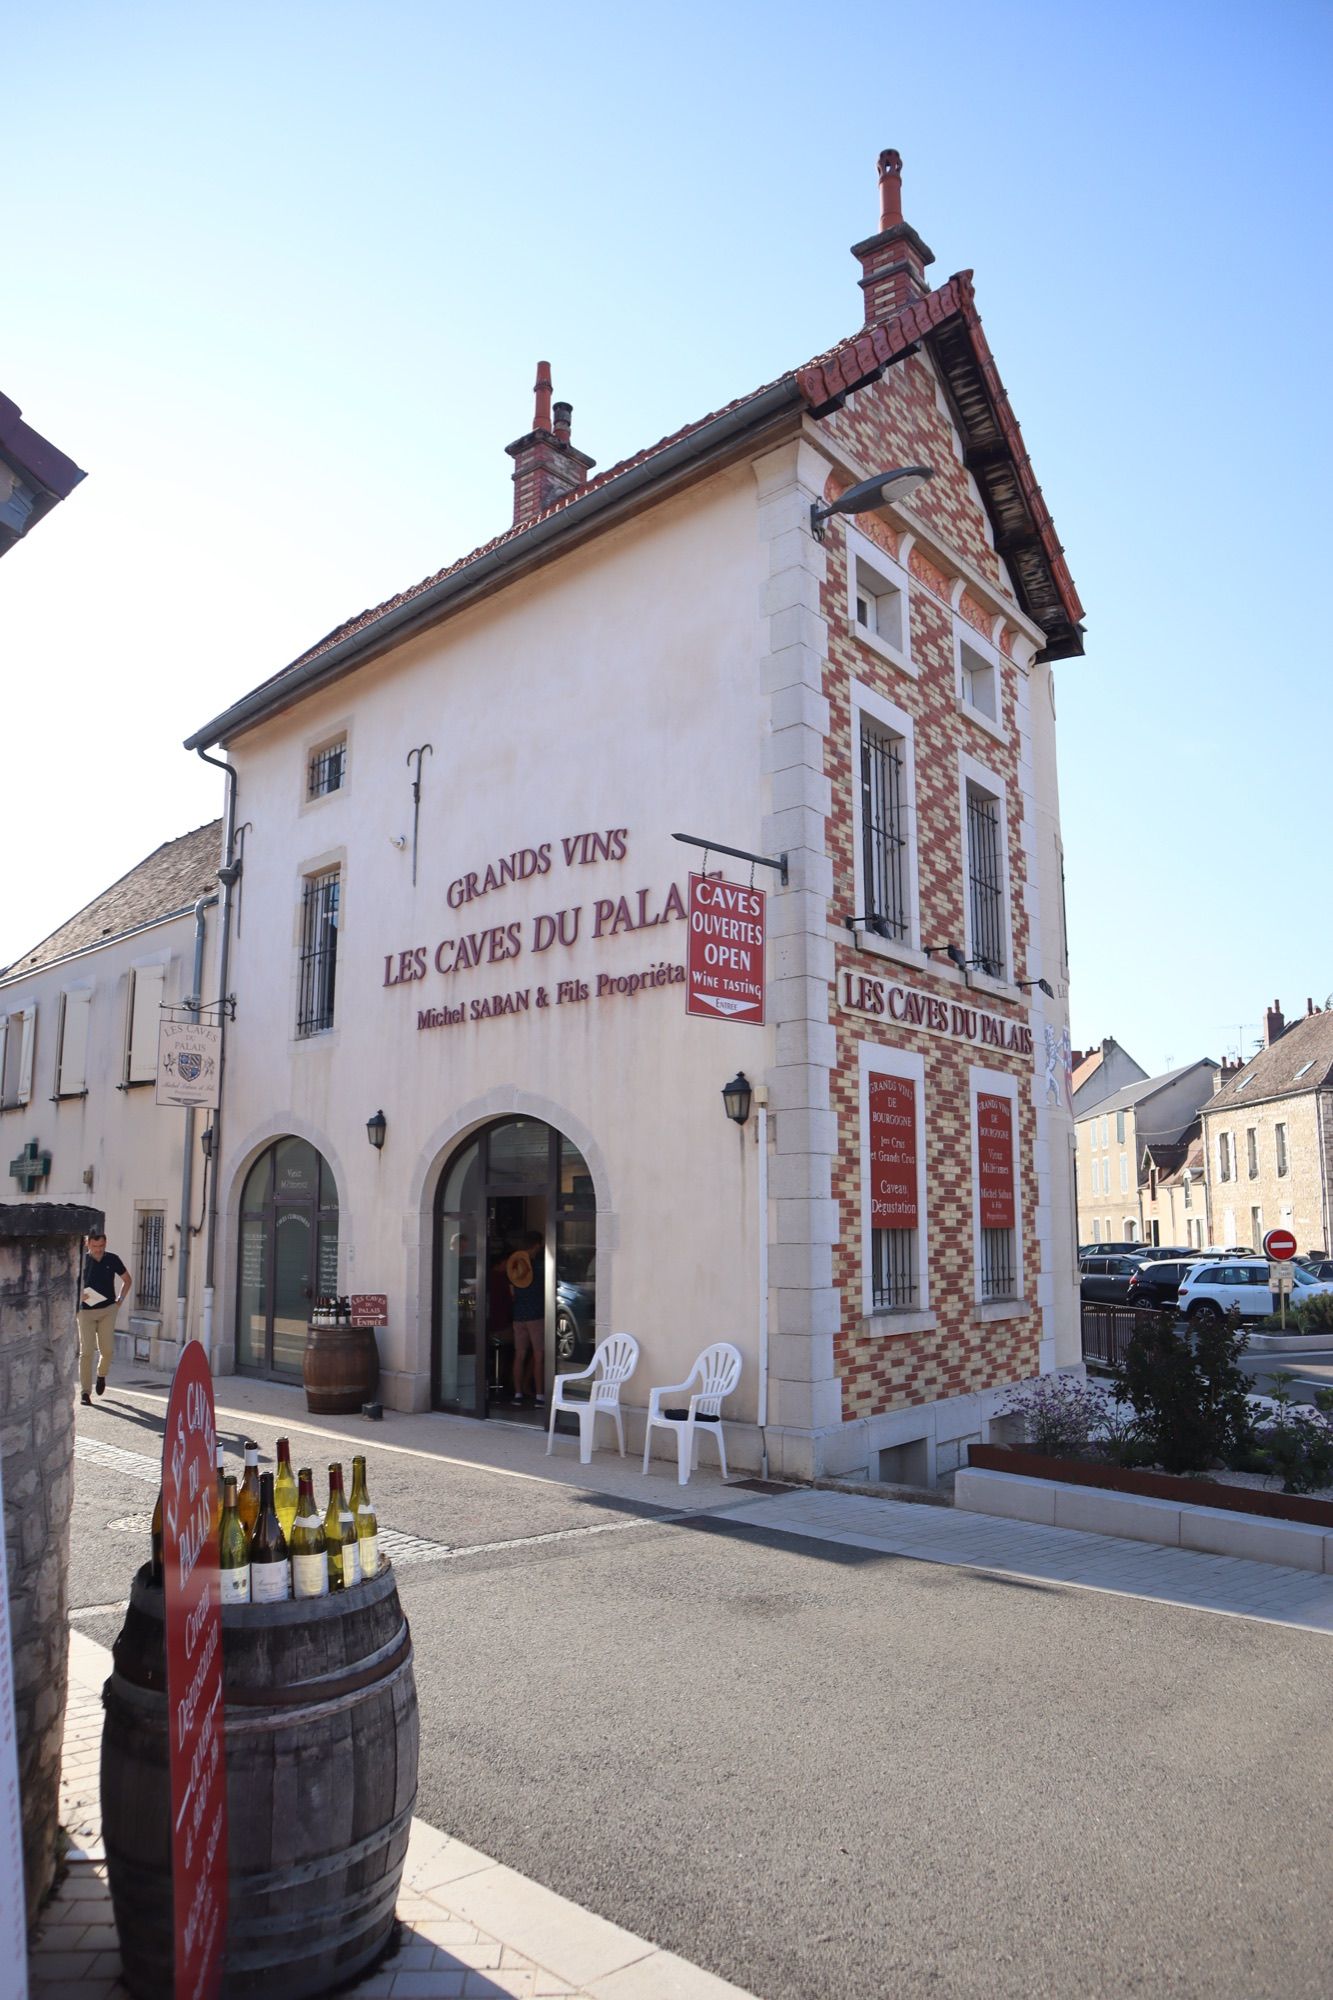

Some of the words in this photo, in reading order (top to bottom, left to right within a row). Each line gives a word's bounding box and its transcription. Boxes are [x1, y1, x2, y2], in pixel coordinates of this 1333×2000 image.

[446, 842, 552, 909] GRANDS
[560, 828, 628, 867] VINS
[695, 882, 761, 917] CAVES
[382, 946, 427, 987] LES
[434, 922, 522, 974] CAVES
[531, 906, 582, 952] DU
[592, 881, 689, 938] PALA
[691, 910, 763, 946] OUVERTES
[704, 943, 751, 972] OPEN
[416, 1001, 466, 1030] Michel
[470, 988, 531, 1021] SABAN
[535, 985, 550, 1009] &
[556, 978, 590, 1005] Fils
[595, 961, 686, 998] Propriéta
[843, 972, 885, 1015] LES
[888, 986, 949, 1032] CAVES
[951, 1004, 978, 1040] DU
[980, 1014, 1034, 1055] PALAIS
[872, 1111, 913, 1127] BOURGOGNE
[887, 1096, 897, 1108] DE
[871, 1198, 917, 1217] Dégustation
[187, 1381, 215, 1472] CAVES
[188, 1455, 199, 1503] DU
[179, 1486, 211, 1593] PALAIS
